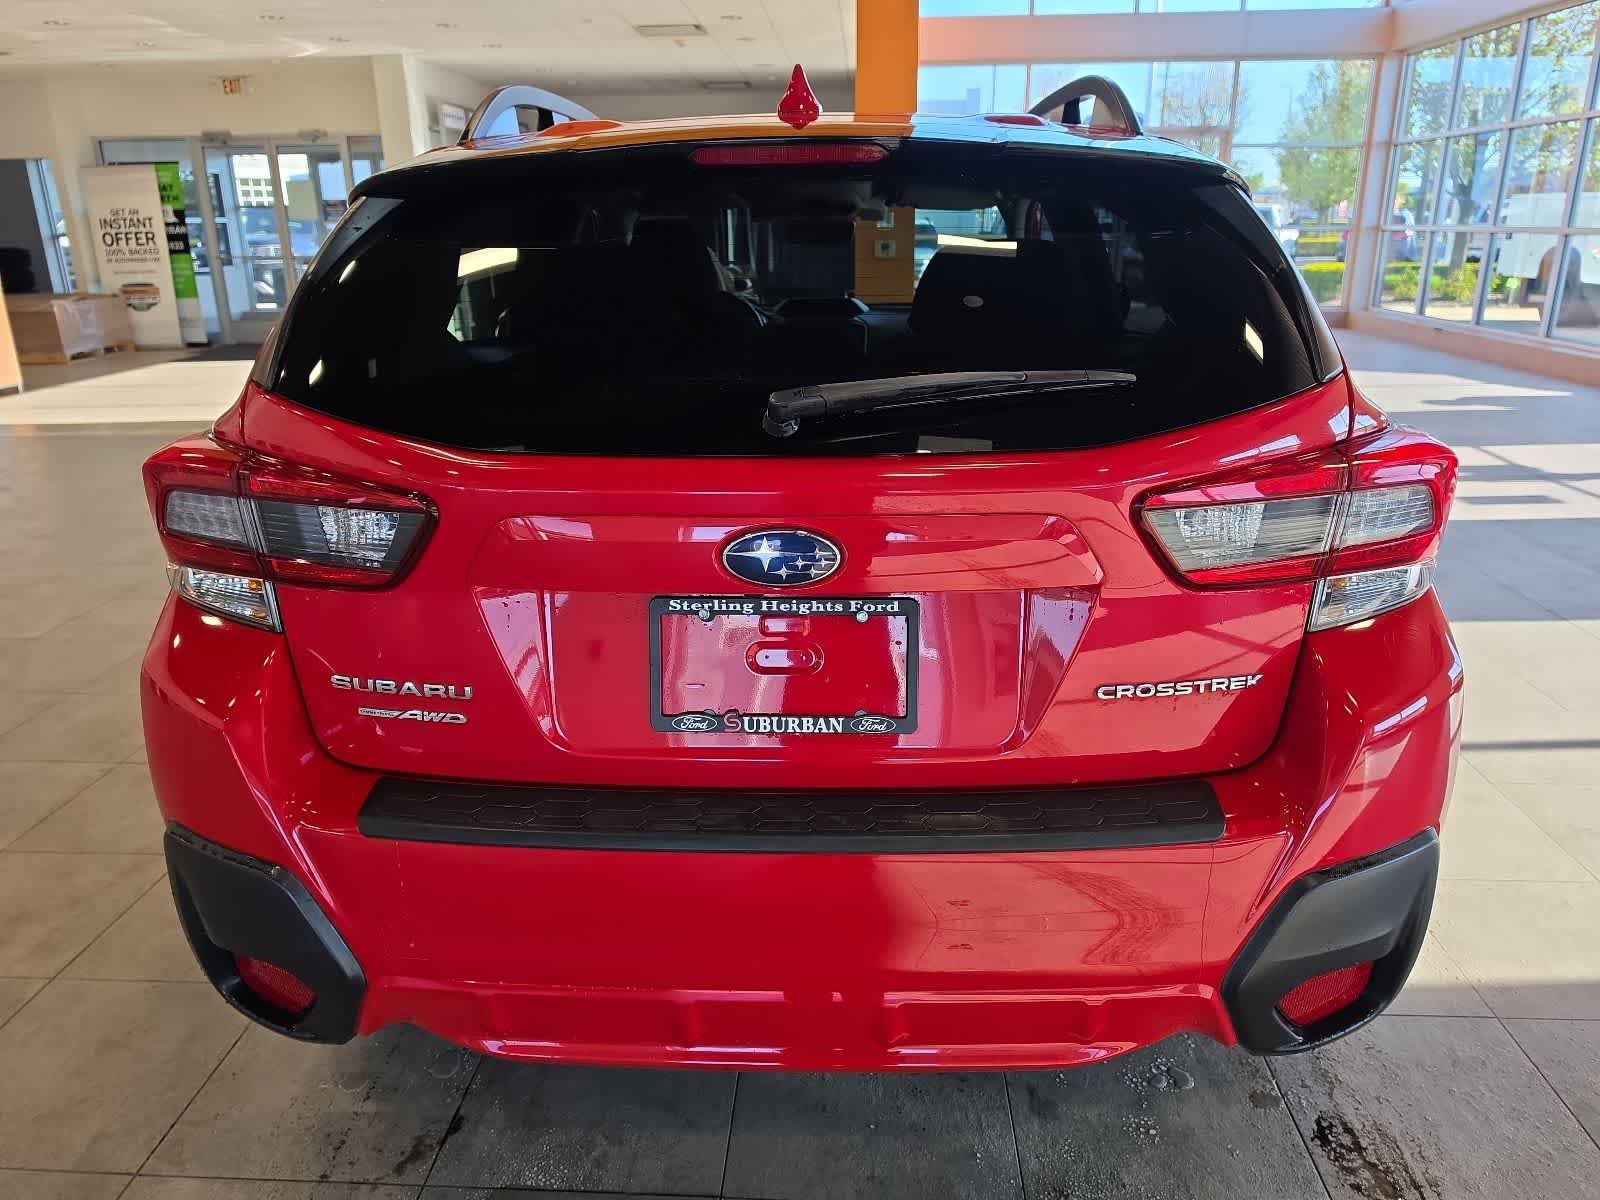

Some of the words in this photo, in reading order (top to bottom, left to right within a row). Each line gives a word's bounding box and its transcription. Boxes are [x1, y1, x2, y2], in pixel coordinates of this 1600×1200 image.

[110, 208, 125, 217] GET
[99, 217, 153, 230] INSTANT
[102, 231, 157, 247] OFFER
[668, 599, 755, 614] Sterling
[760, 599, 844, 614] Heights
[850, 600, 901, 613] Ford
[330, 674, 473, 700] SUBARU
[1096, 674, 1264, 700] CROSSTREK
[398, 709, 468, 724] AWD
[680, 716, 709, 731] Ford
[724, 711, 845, 733] SUBURBAN
[857, 717, 888, 732] Ford
